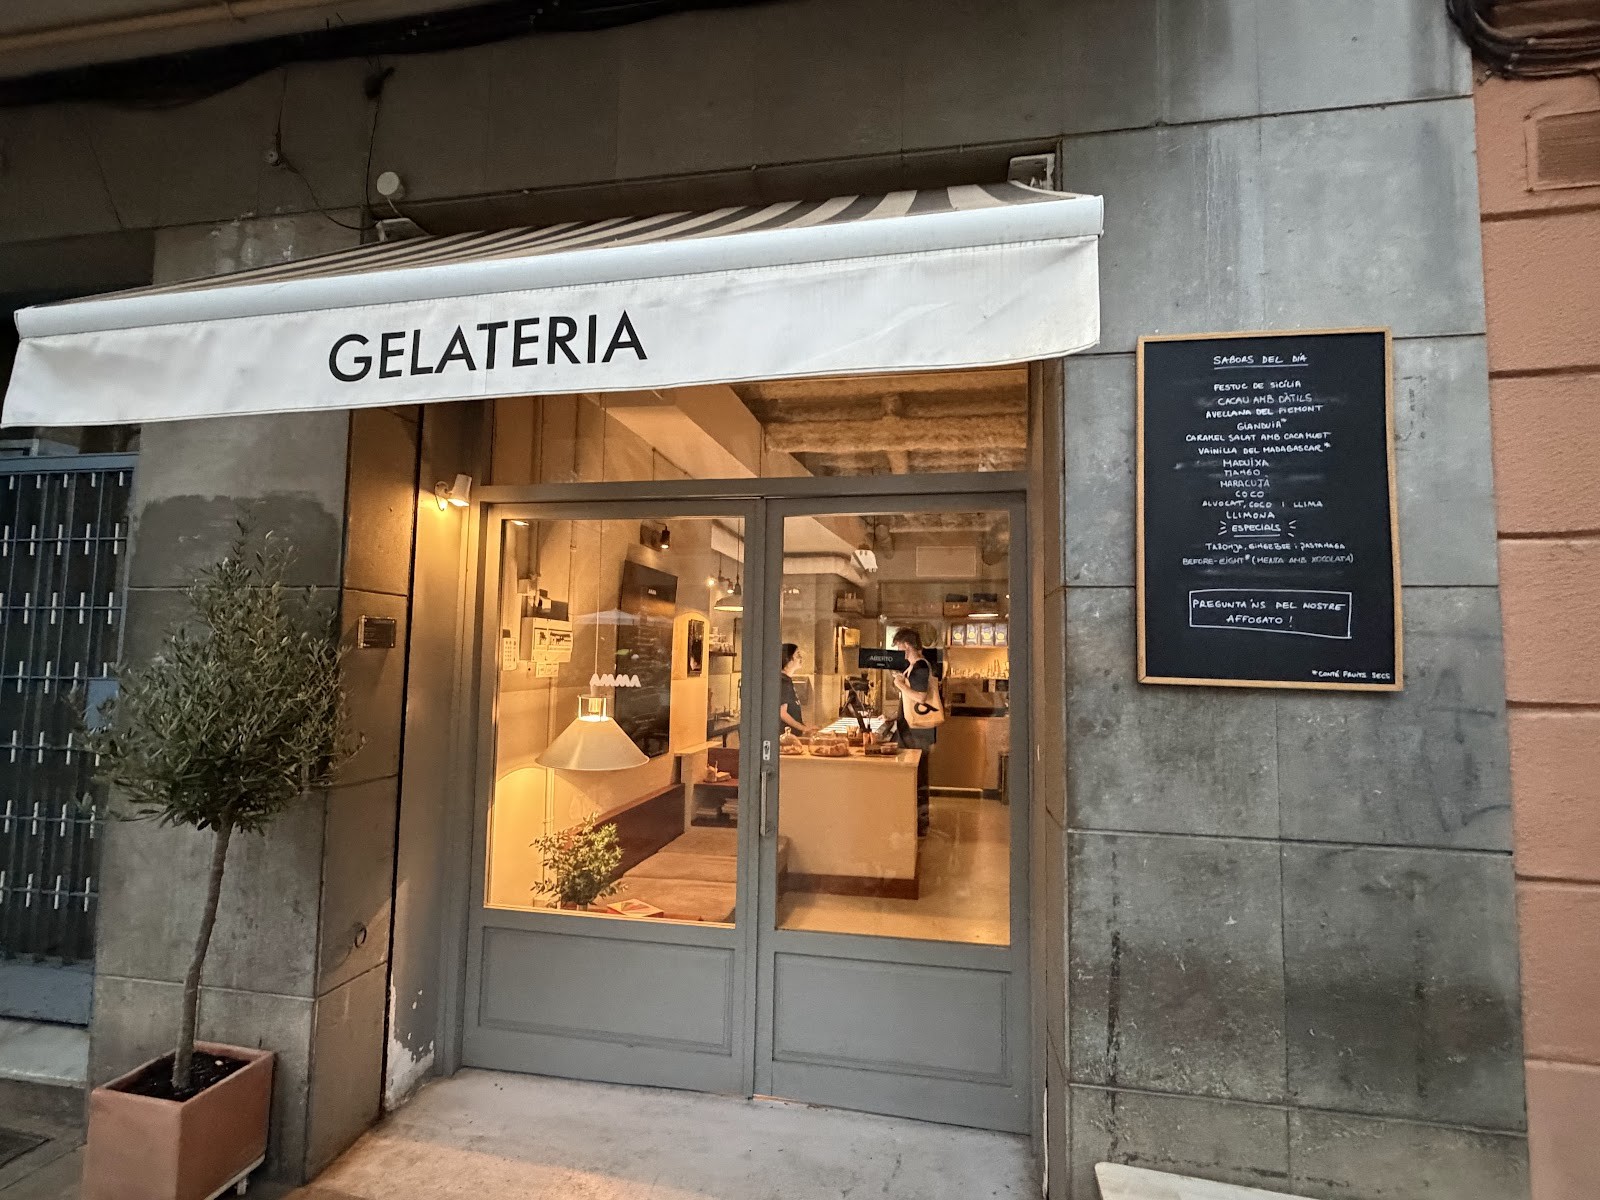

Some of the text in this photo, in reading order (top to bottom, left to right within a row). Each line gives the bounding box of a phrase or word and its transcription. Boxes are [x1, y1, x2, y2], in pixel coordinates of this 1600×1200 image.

[329, 310, 647, 382] GELATERIA
[1213, 355, 1254, 365] SABORS
[1262, 355, 1283, 364] DEL
[1214, 383, 1248, 391] FESTUC
[1217, 392, 1312, 406] CACAU AMB DÀTILS
[1206, 405, 1323, 418] AVELLANA DEL PIEMONT
[1185, 434, 1225, 442] CARAMEL
[1228, 434, 1256, 442] SALAT
[1260, 433, 1281, 441] AMB
[1198, 446, 1238, 455] VAINILLA
[1223, 459, 1270, 468] MADUIXA
[1224, 469, 1260, 477] MANGO
[1235, 490, 1265, 498] COCO
[1202, 500, 1247, 509] ALVOCAT,
[1248, 501, 1272, 509] COCO
[1293, 500, 1323, 508] LLIMA
[1226, 511, 1275, 519] LLIMONA
[1231, 523, 1282, 532] ESPECIALS
[1302, 602, 1346, 610] NOSTRE
[1226, 615, 1283, 624] AFFOGATO
